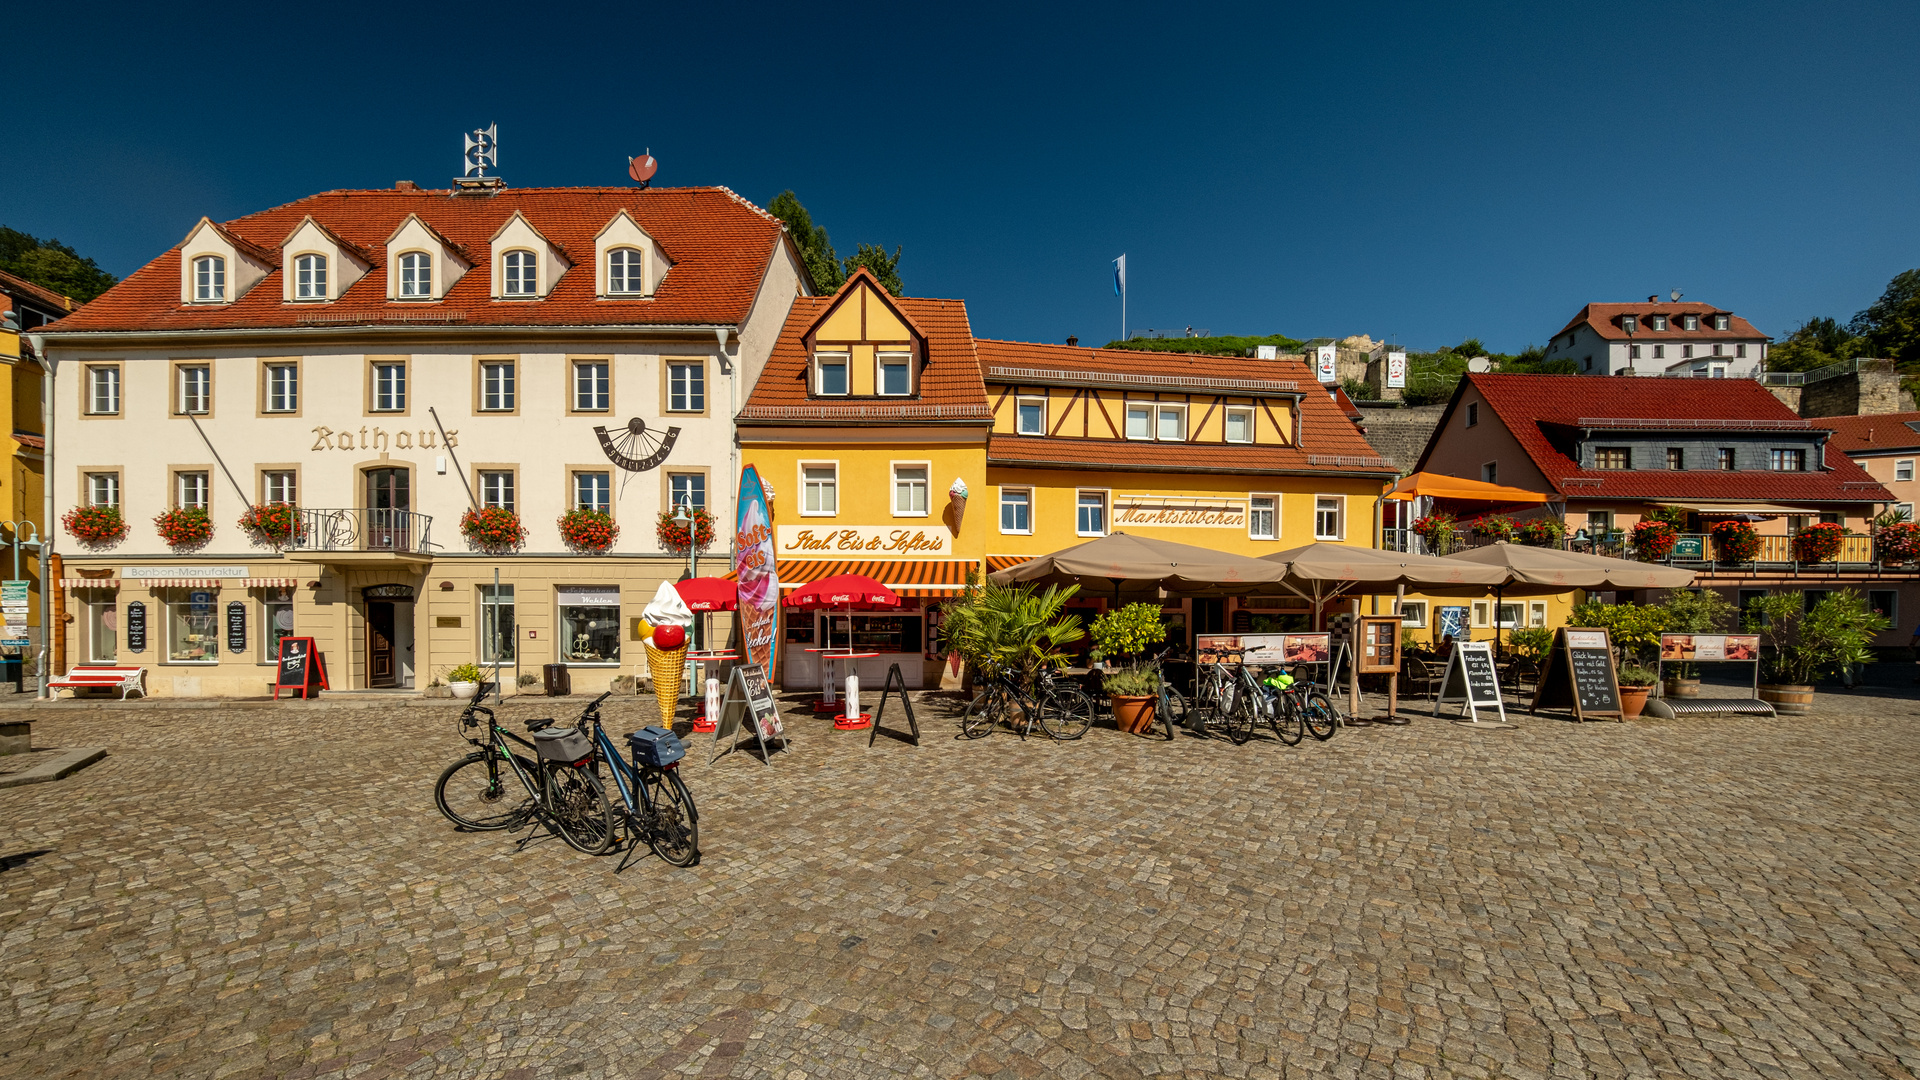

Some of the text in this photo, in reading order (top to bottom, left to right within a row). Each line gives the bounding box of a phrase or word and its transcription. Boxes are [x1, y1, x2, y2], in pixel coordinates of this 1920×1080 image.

[311, 425, 459, 452] Rathaus
[642, 461, 646, 469] 2
[650, 459, 654, 467] 3
[656, 453, 662, 461] 4
[1115, 503, 1244, 525] Marktstübchen
[736, 523, 772, 553] Soft-
[785, 529, 943, 554] Ital. Eis & Softeis
[745, 548, 766, 571] eis
[131, 567, 242, 577] Bonbon-Manufaktur
[751, 614, 771, 629] einfach
